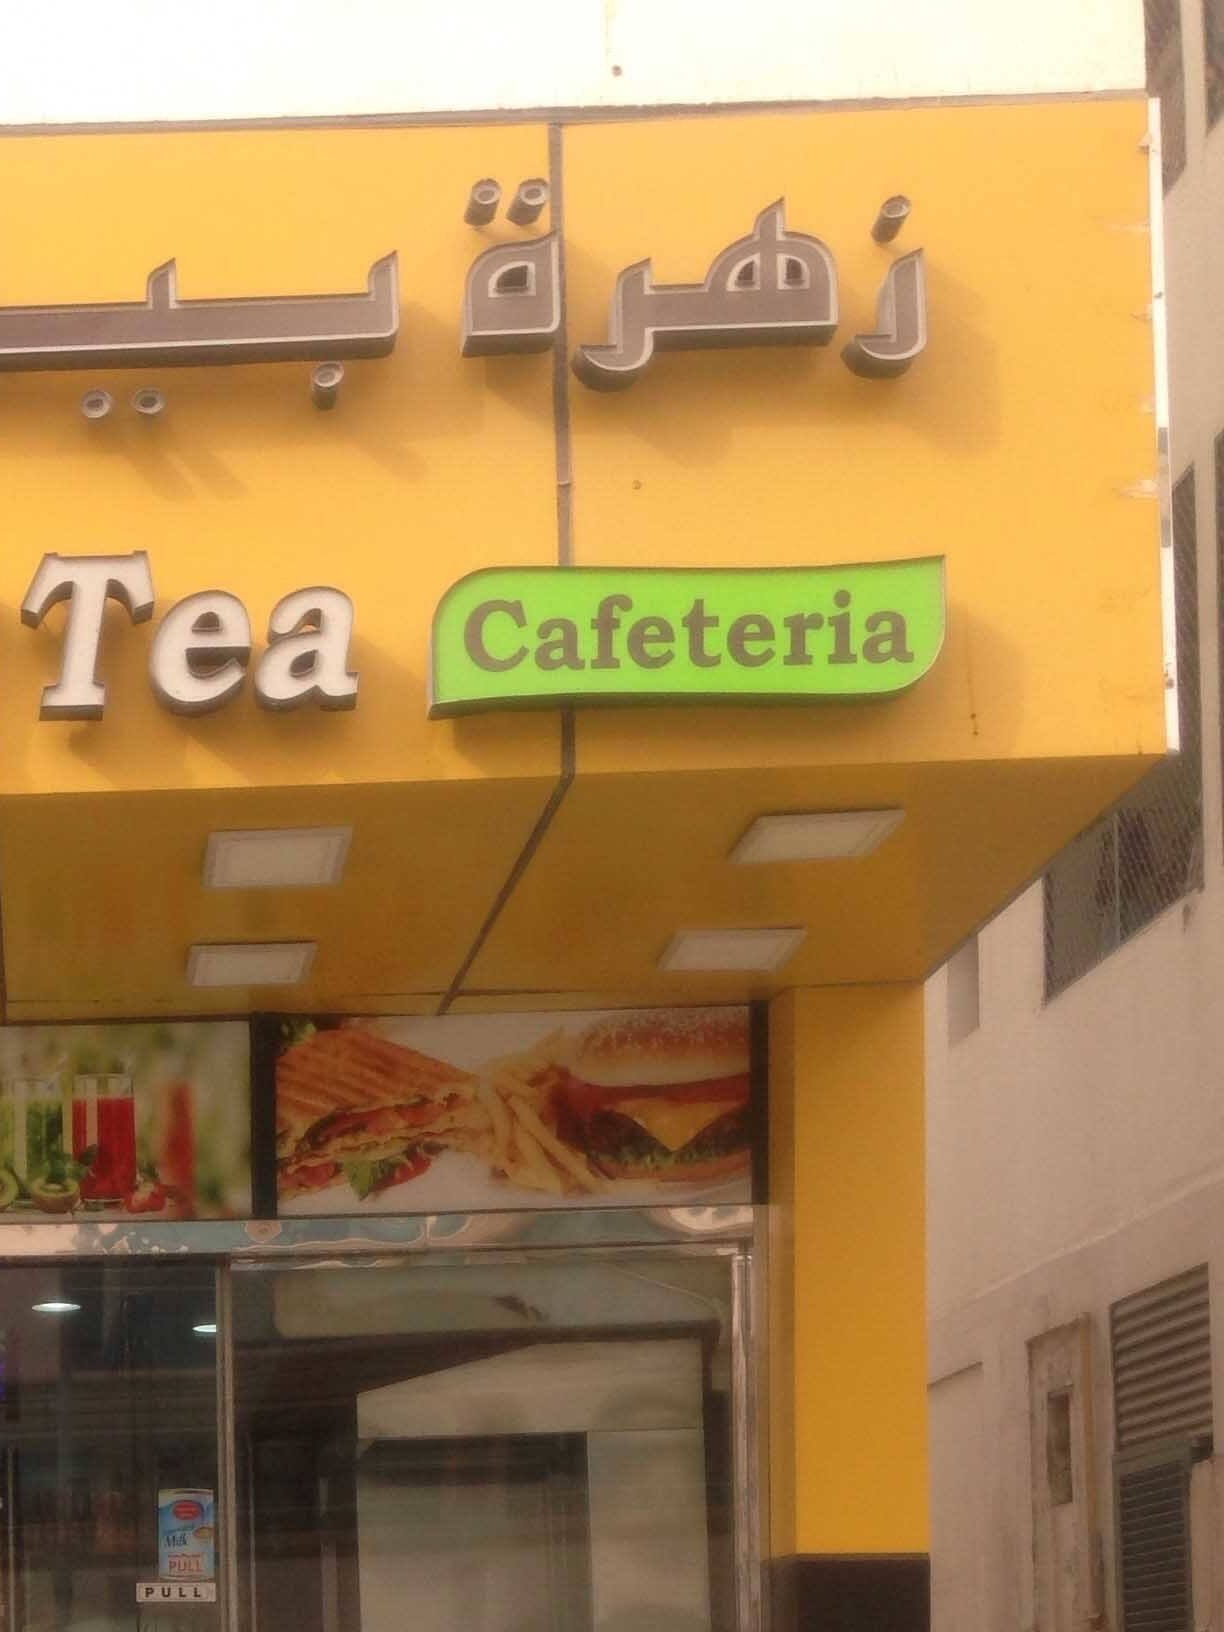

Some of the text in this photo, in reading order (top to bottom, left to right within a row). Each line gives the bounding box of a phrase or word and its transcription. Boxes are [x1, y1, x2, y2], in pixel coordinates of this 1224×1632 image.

[459, 177, 928, 392] زهرة
[20, 549, 359, 722] Tea
[462, 589, 914, 674] Cafeteria
[144, 1586, 203, 1598] PULL
[168, 1559, 204, 1573] PULL
